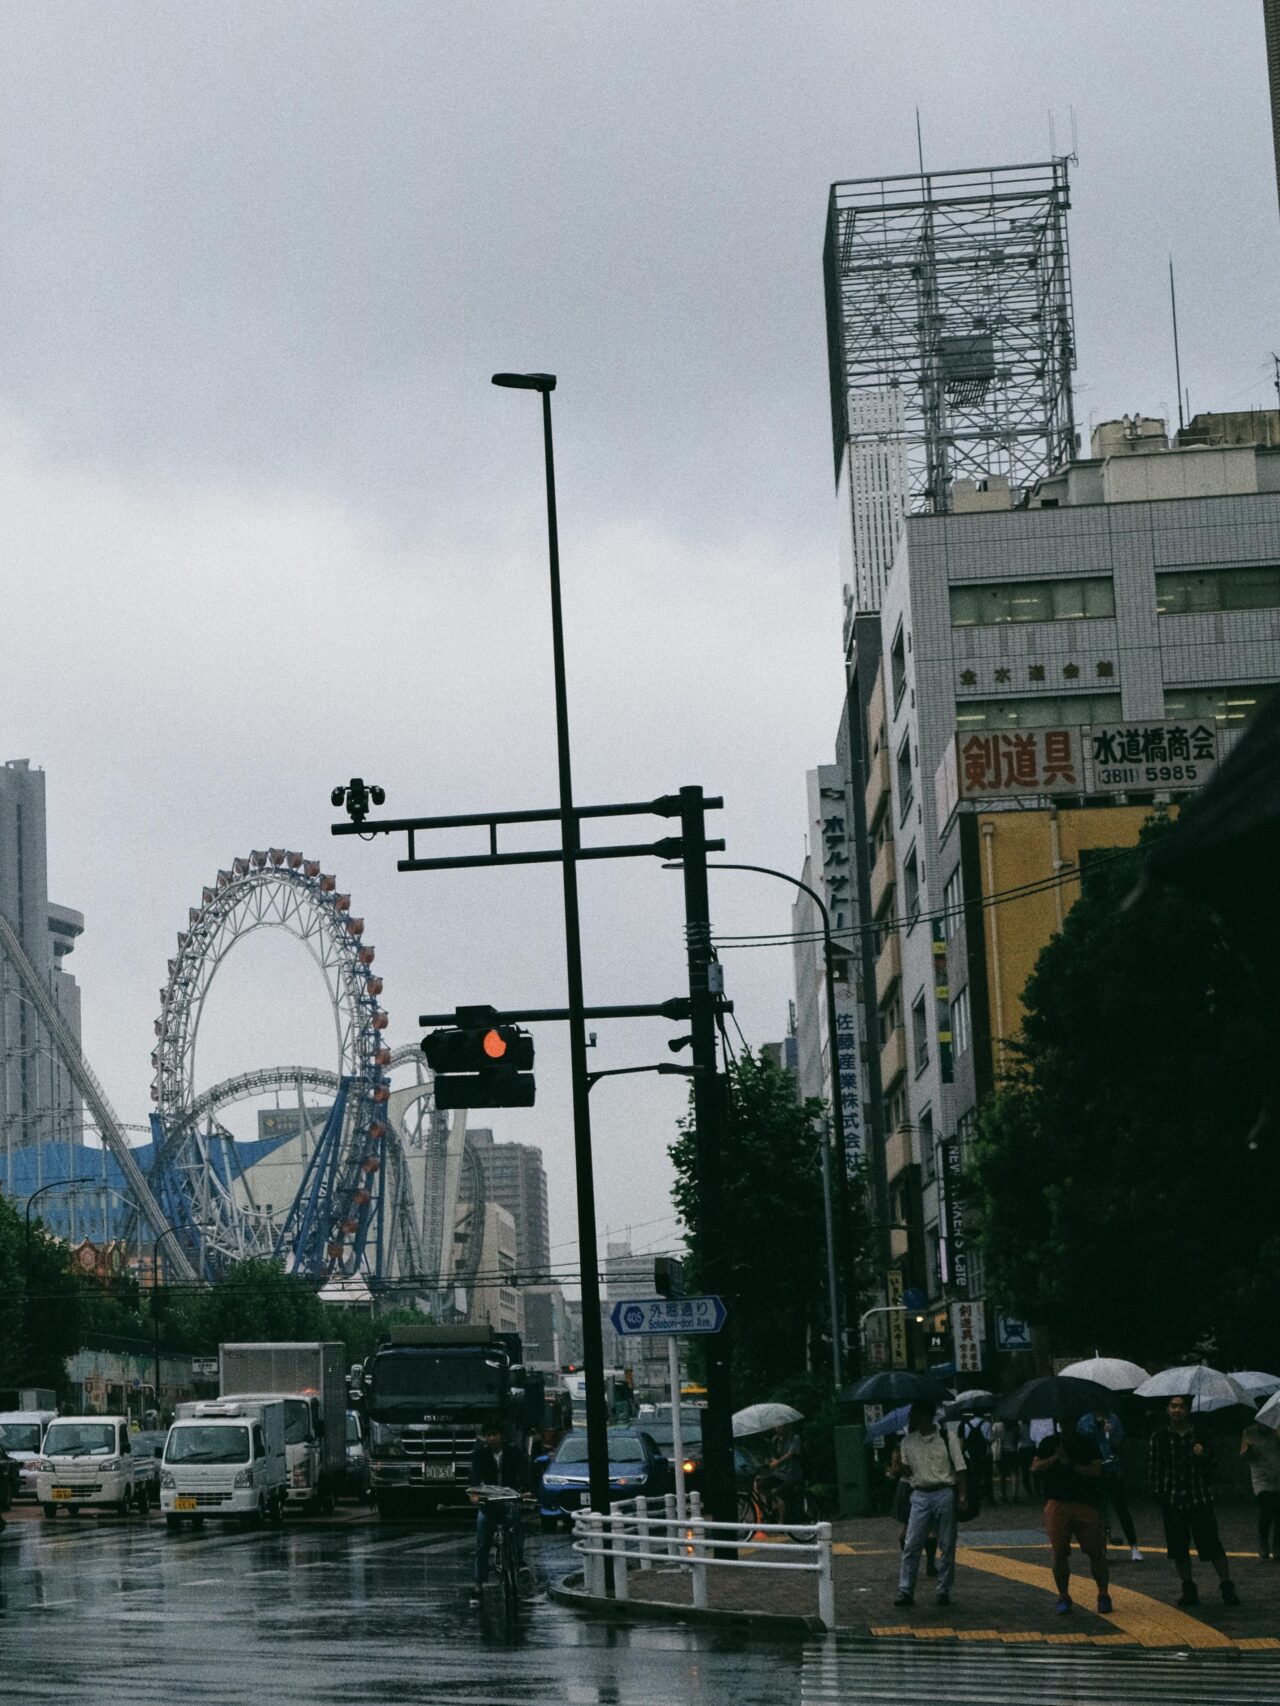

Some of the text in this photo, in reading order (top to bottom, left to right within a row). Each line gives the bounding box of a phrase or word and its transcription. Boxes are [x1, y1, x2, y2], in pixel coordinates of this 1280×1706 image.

[1093, 725, 1215, 766] 水道橋商会
[962, 731, 1077, 792] 剣道具
[1097, 764, 1198, 785] (3811) 5985
[626, 1311, 642, 1324] 405
[649, 1302, 708, 1319] 外堀通り
